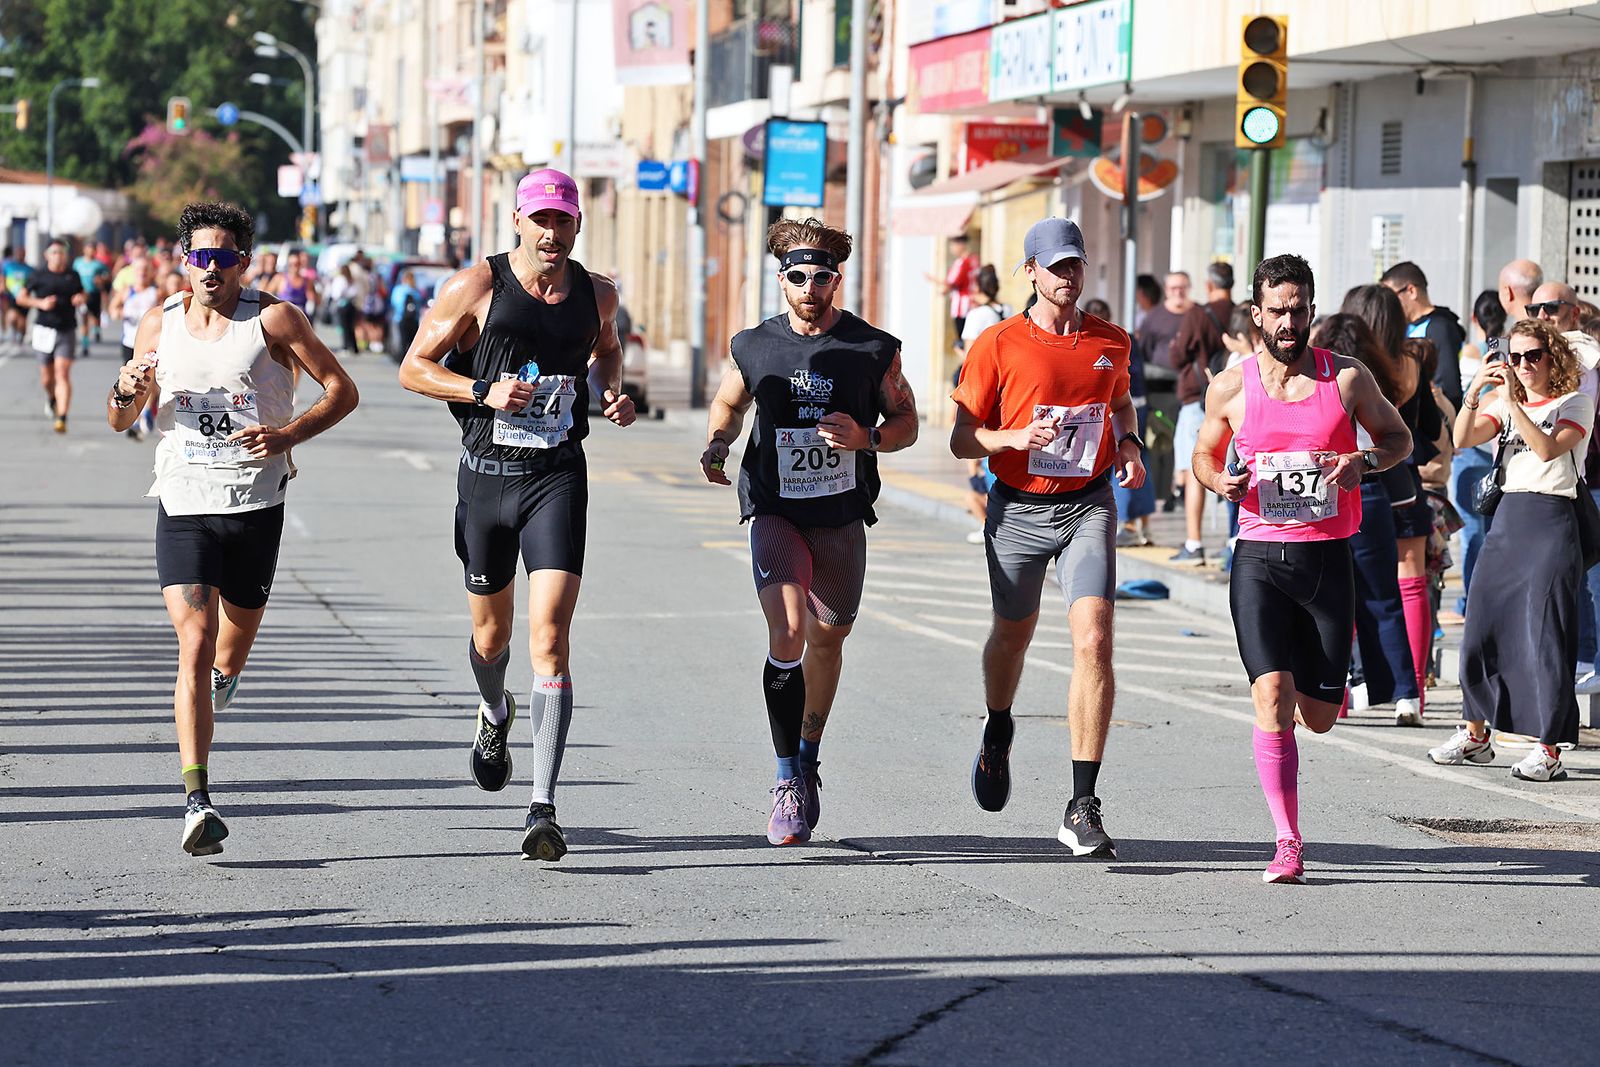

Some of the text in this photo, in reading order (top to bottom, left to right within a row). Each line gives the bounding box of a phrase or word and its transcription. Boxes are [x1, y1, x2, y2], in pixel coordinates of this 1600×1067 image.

[233, 393, 249, 405] 2K
[1089, 406, 1101, 418] 2K
[198, 413, 234, 437] 84
[497, 423, 534, 432] TORNERO
[781, 431, 795, 443] 2K
[1064, 425, 1078, 448] 7
[185, 440, 211, 449] BRIOSO
[790, 447, 841, 471] 205
[1262, 455, 1275, 467] 2K
[782, 470, 848, 484] BARRAGAN RAMOS
[1272, 470, 1322, 496] 137
[783, 482, 815, 492] Huelva
[1266, 501, 1300, 509] BARNETO
[1302, 498, 1329, 507] ALANIS
[1263, 508, 1297, 517] Huelva
